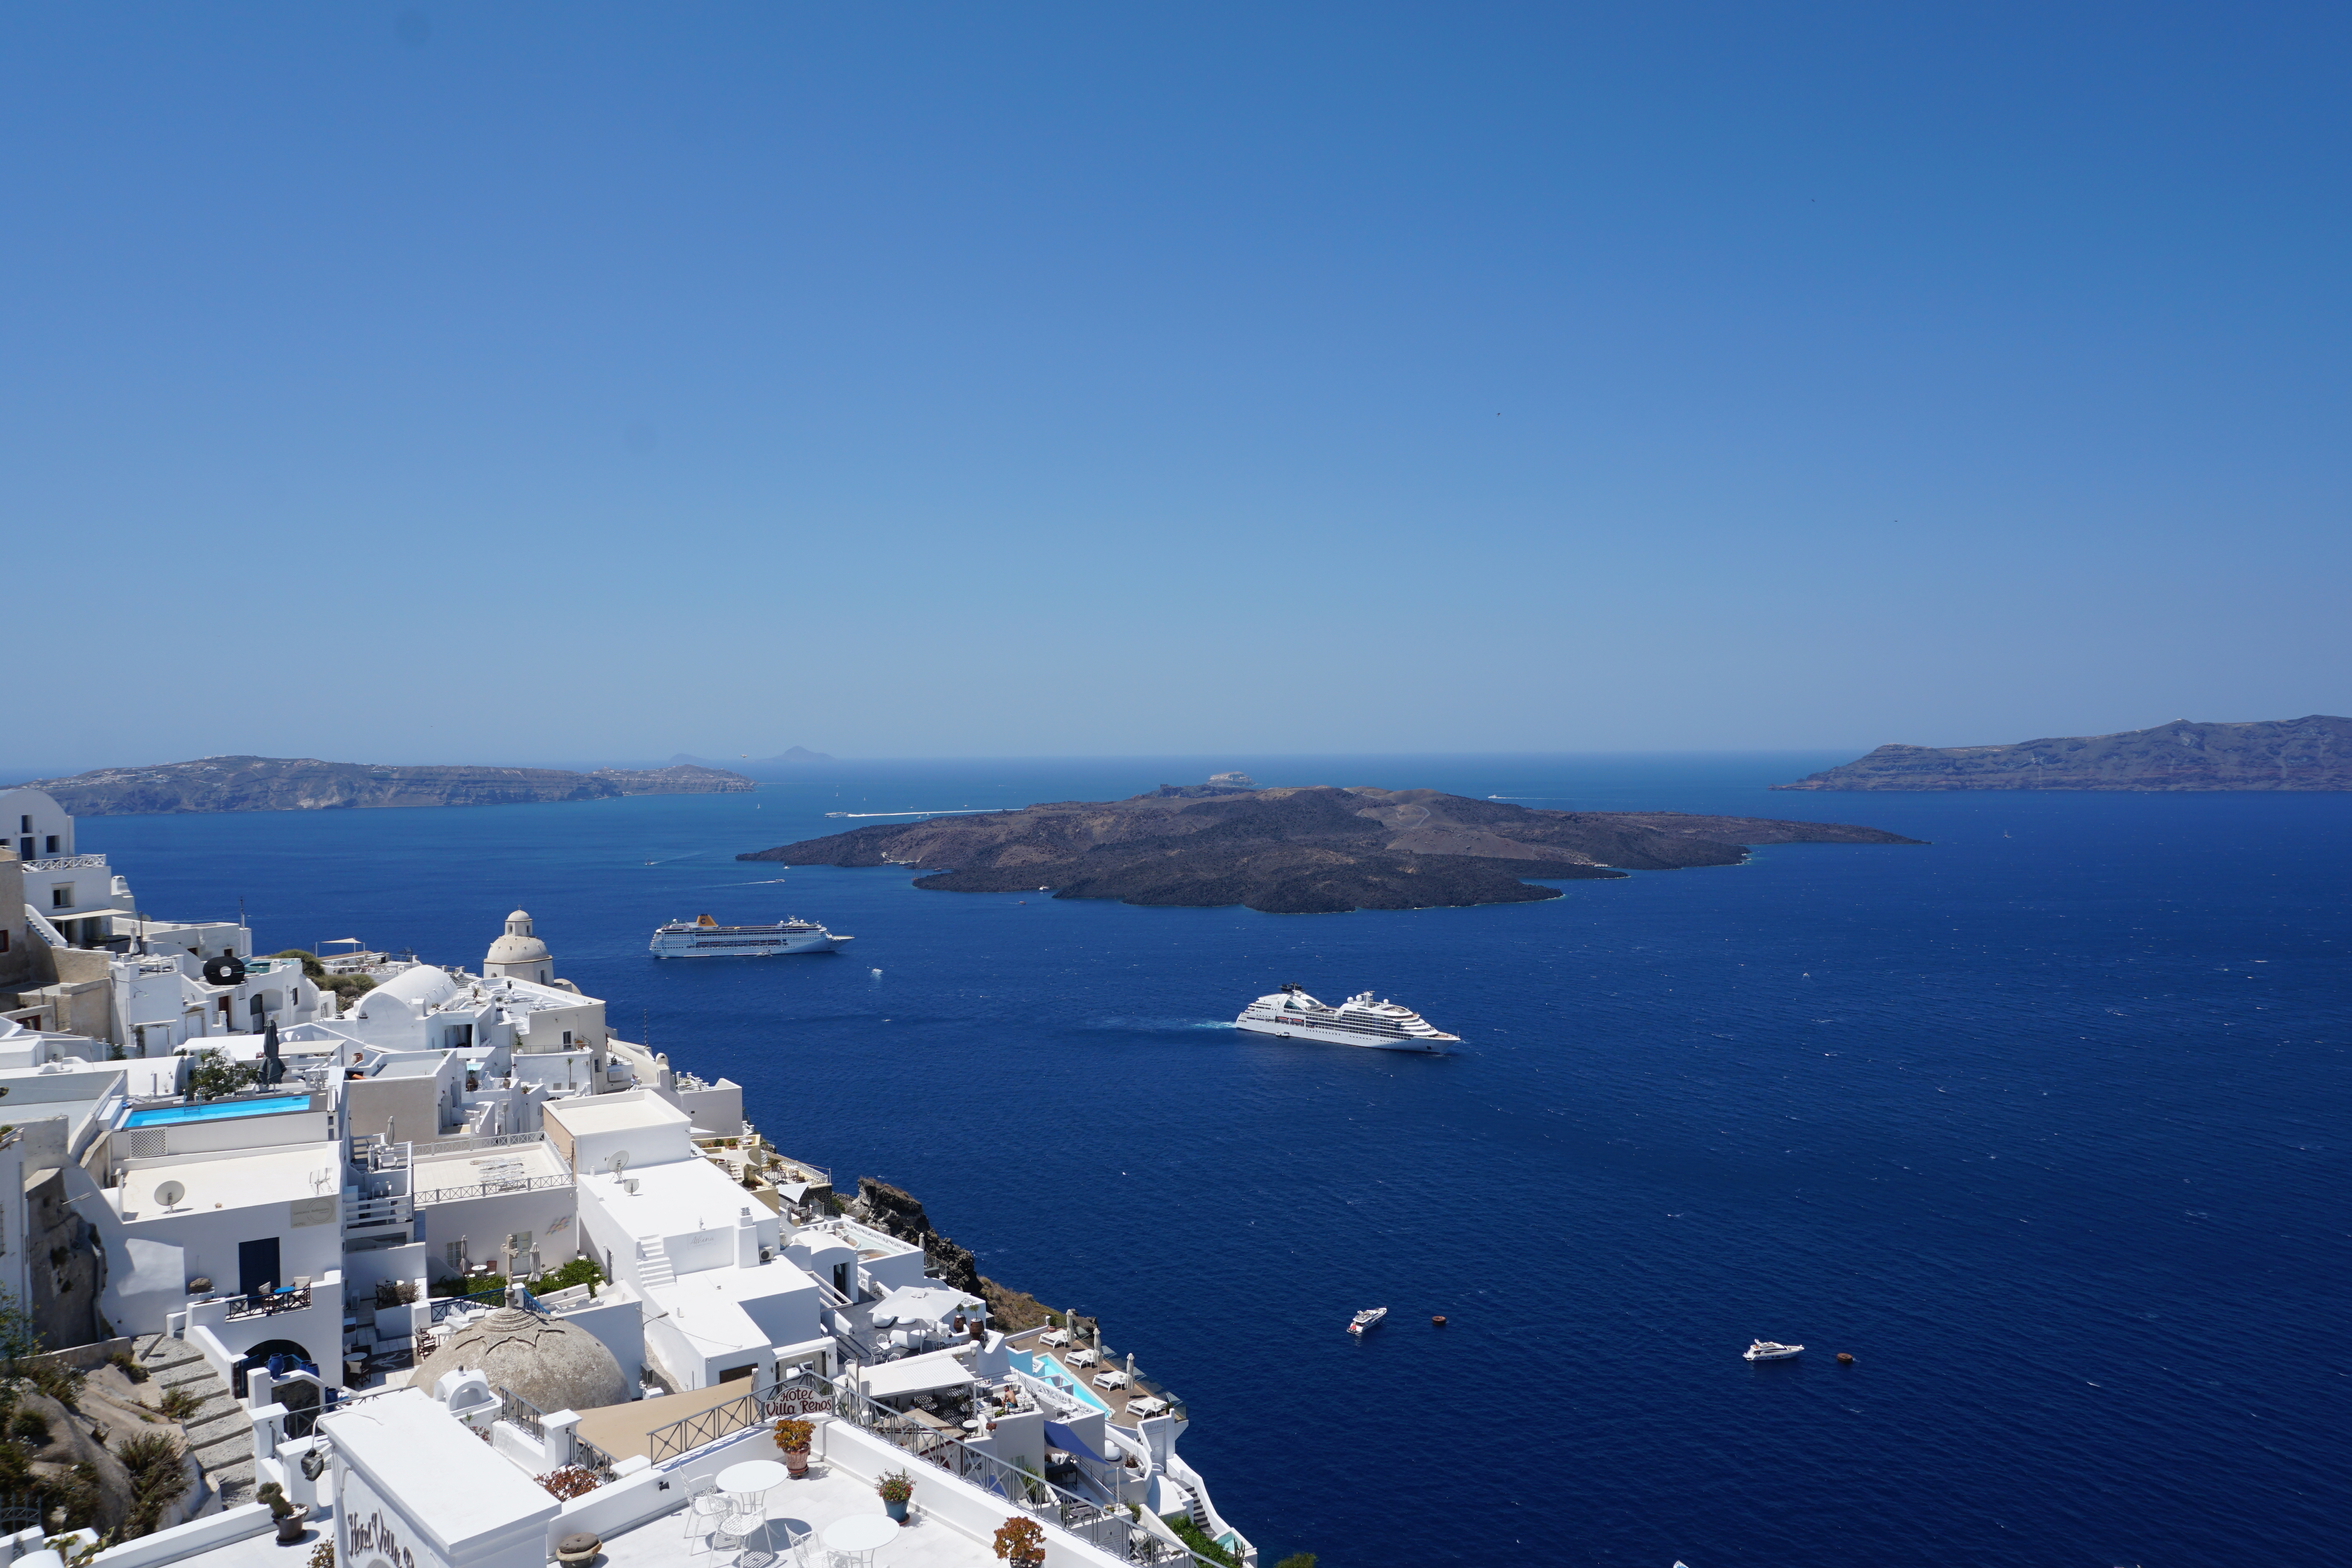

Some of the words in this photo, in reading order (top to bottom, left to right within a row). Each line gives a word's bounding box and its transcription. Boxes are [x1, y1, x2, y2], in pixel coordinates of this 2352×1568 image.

[780, 1388, 814, 1402] Hotel
[766, 1402, 796, 1416] Villa
[800, 1399, 831, 1413] Renos
[348, 1511, 373, 1556] Hotel
[372, 1507, 402, 1568] Villa
